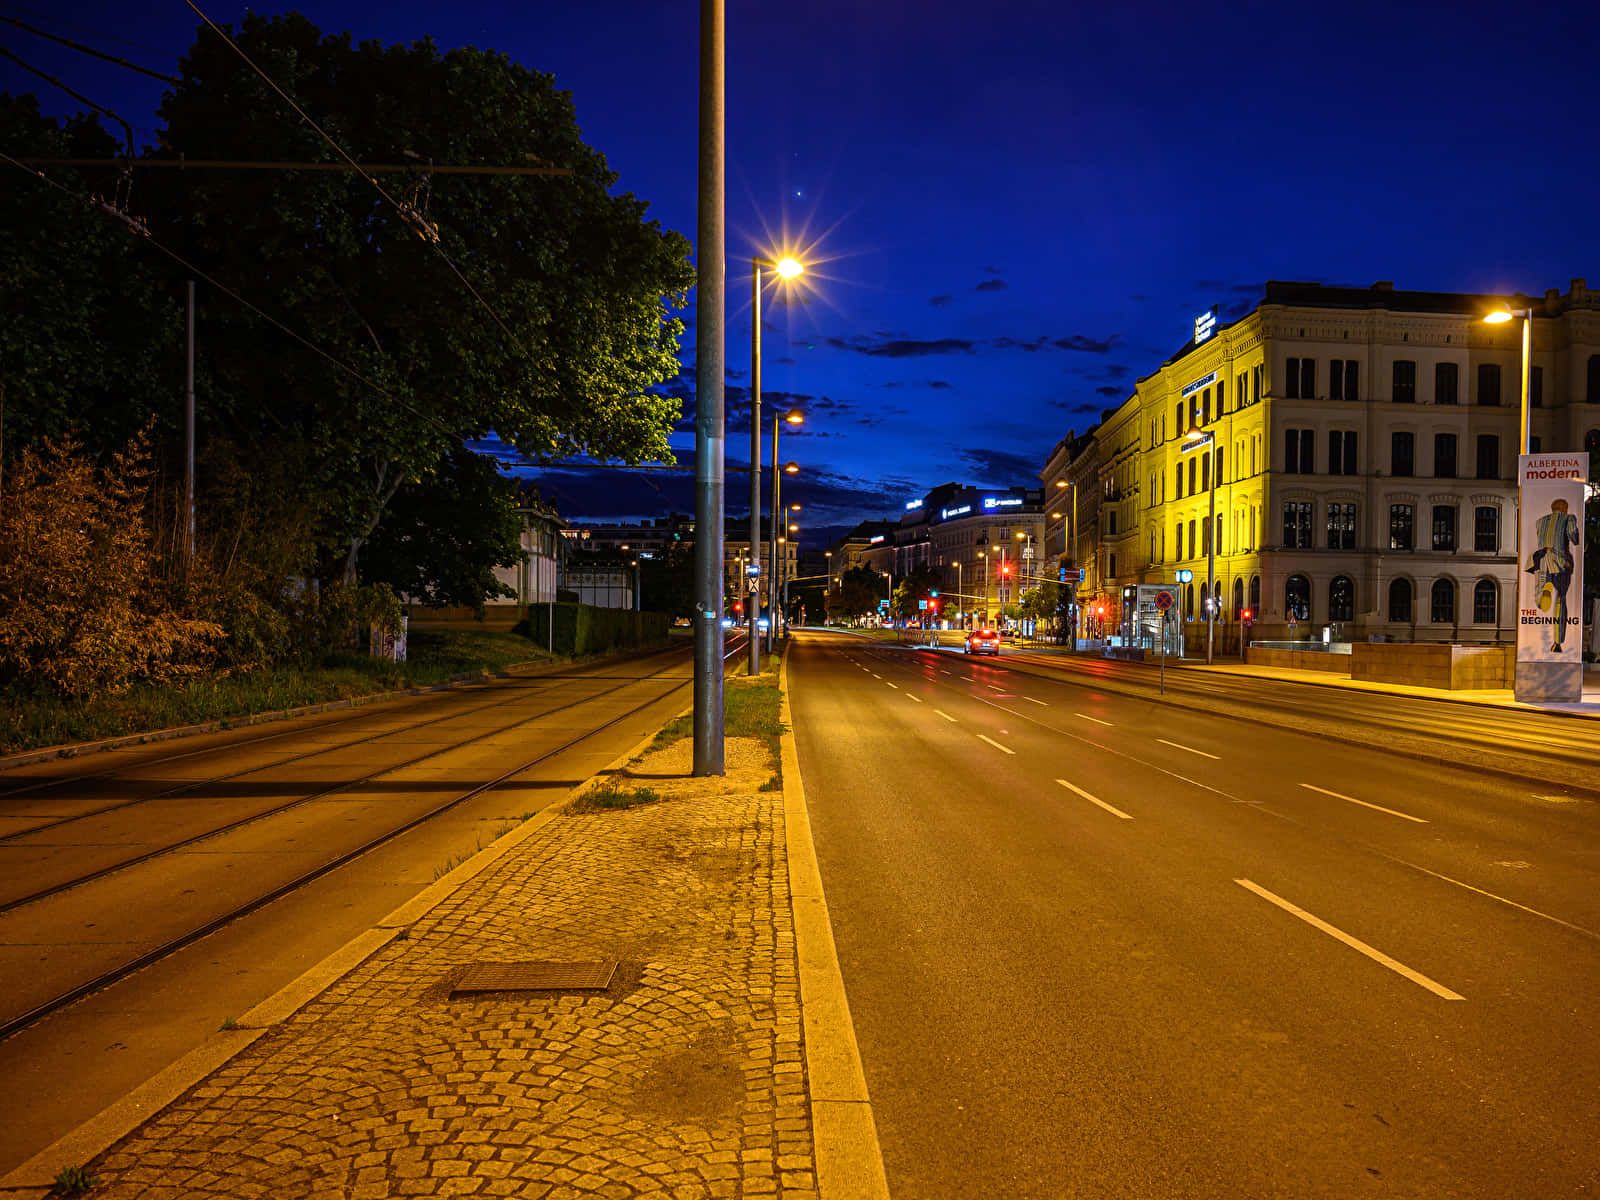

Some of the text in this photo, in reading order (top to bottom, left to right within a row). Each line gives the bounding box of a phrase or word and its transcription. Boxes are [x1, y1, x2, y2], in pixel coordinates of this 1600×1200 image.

[1528, 459, 1579, 468] ALBERTINA
[1526, 468, 1580, 479] modern
[1521, 616, 1580, 625] BEGINNNG
